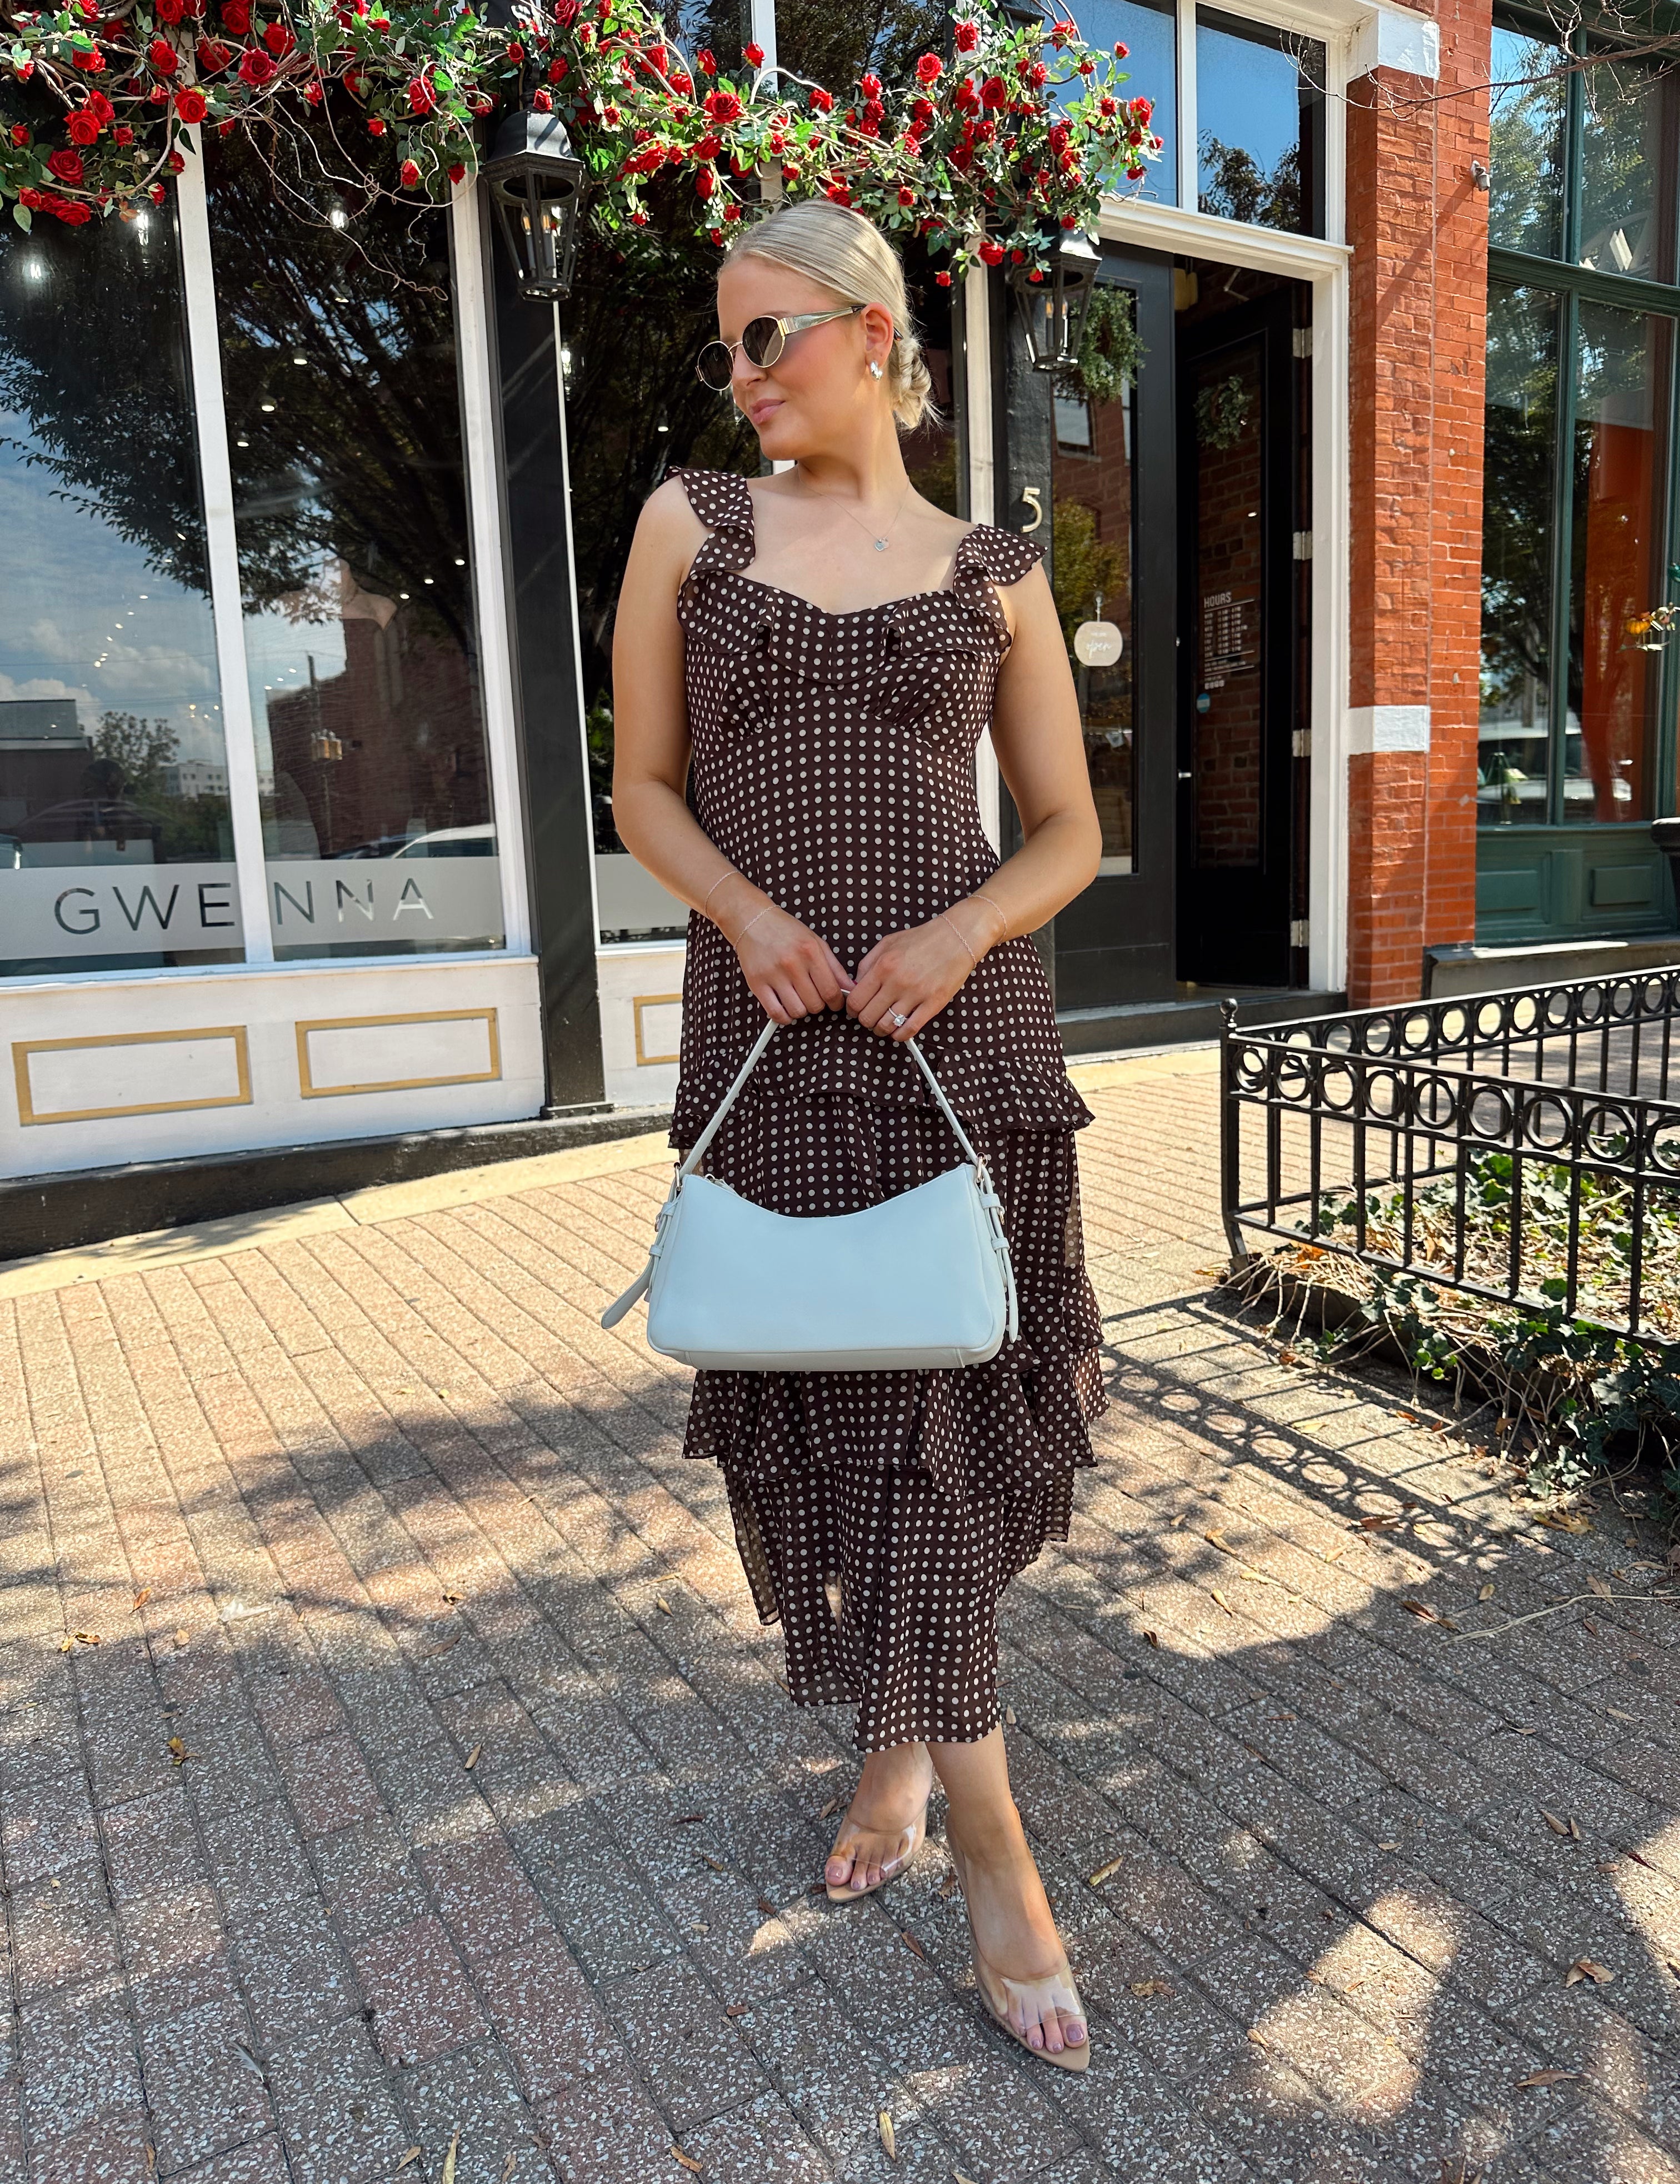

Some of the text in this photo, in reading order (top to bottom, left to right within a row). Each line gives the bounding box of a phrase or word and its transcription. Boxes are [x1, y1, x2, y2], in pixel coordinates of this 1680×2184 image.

[1021, 487, 1042, 533] 5
[1204, 591, 1232, 608] HOURS
[1086, 639, 1112, 659] open
[54, 878, 434, 934] GWENNA
